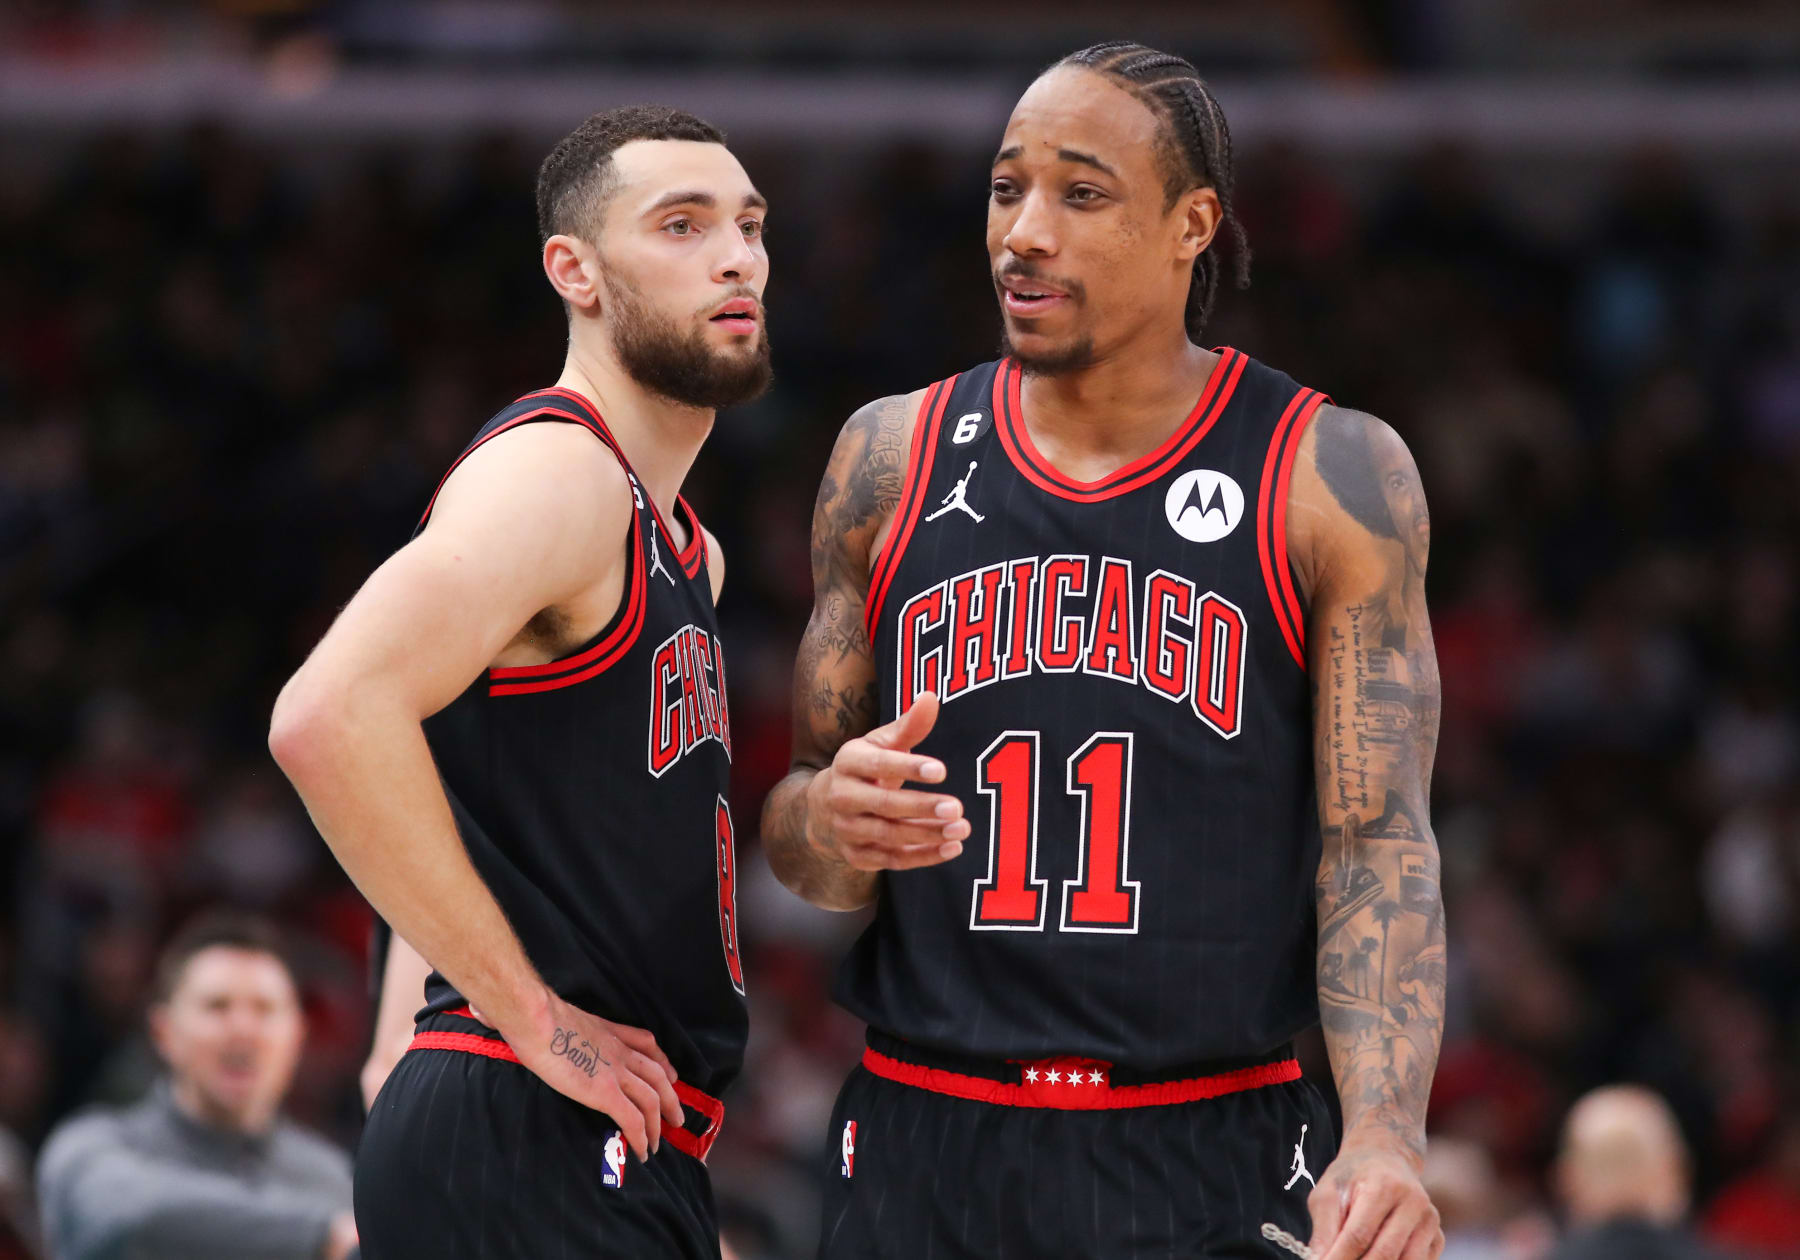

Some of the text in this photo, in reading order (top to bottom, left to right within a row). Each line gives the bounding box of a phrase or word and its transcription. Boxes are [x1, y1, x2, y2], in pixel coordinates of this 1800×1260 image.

[952, 412, 982, 445] 6
[896, 555, 1248, 740] CHICAGO
[969, 730, 1141, 935] 11
[716, 793, 745, 997] 8
[550, 1027, 611, 1078] Saint
[603, 1174, 616, 1185] NBA
